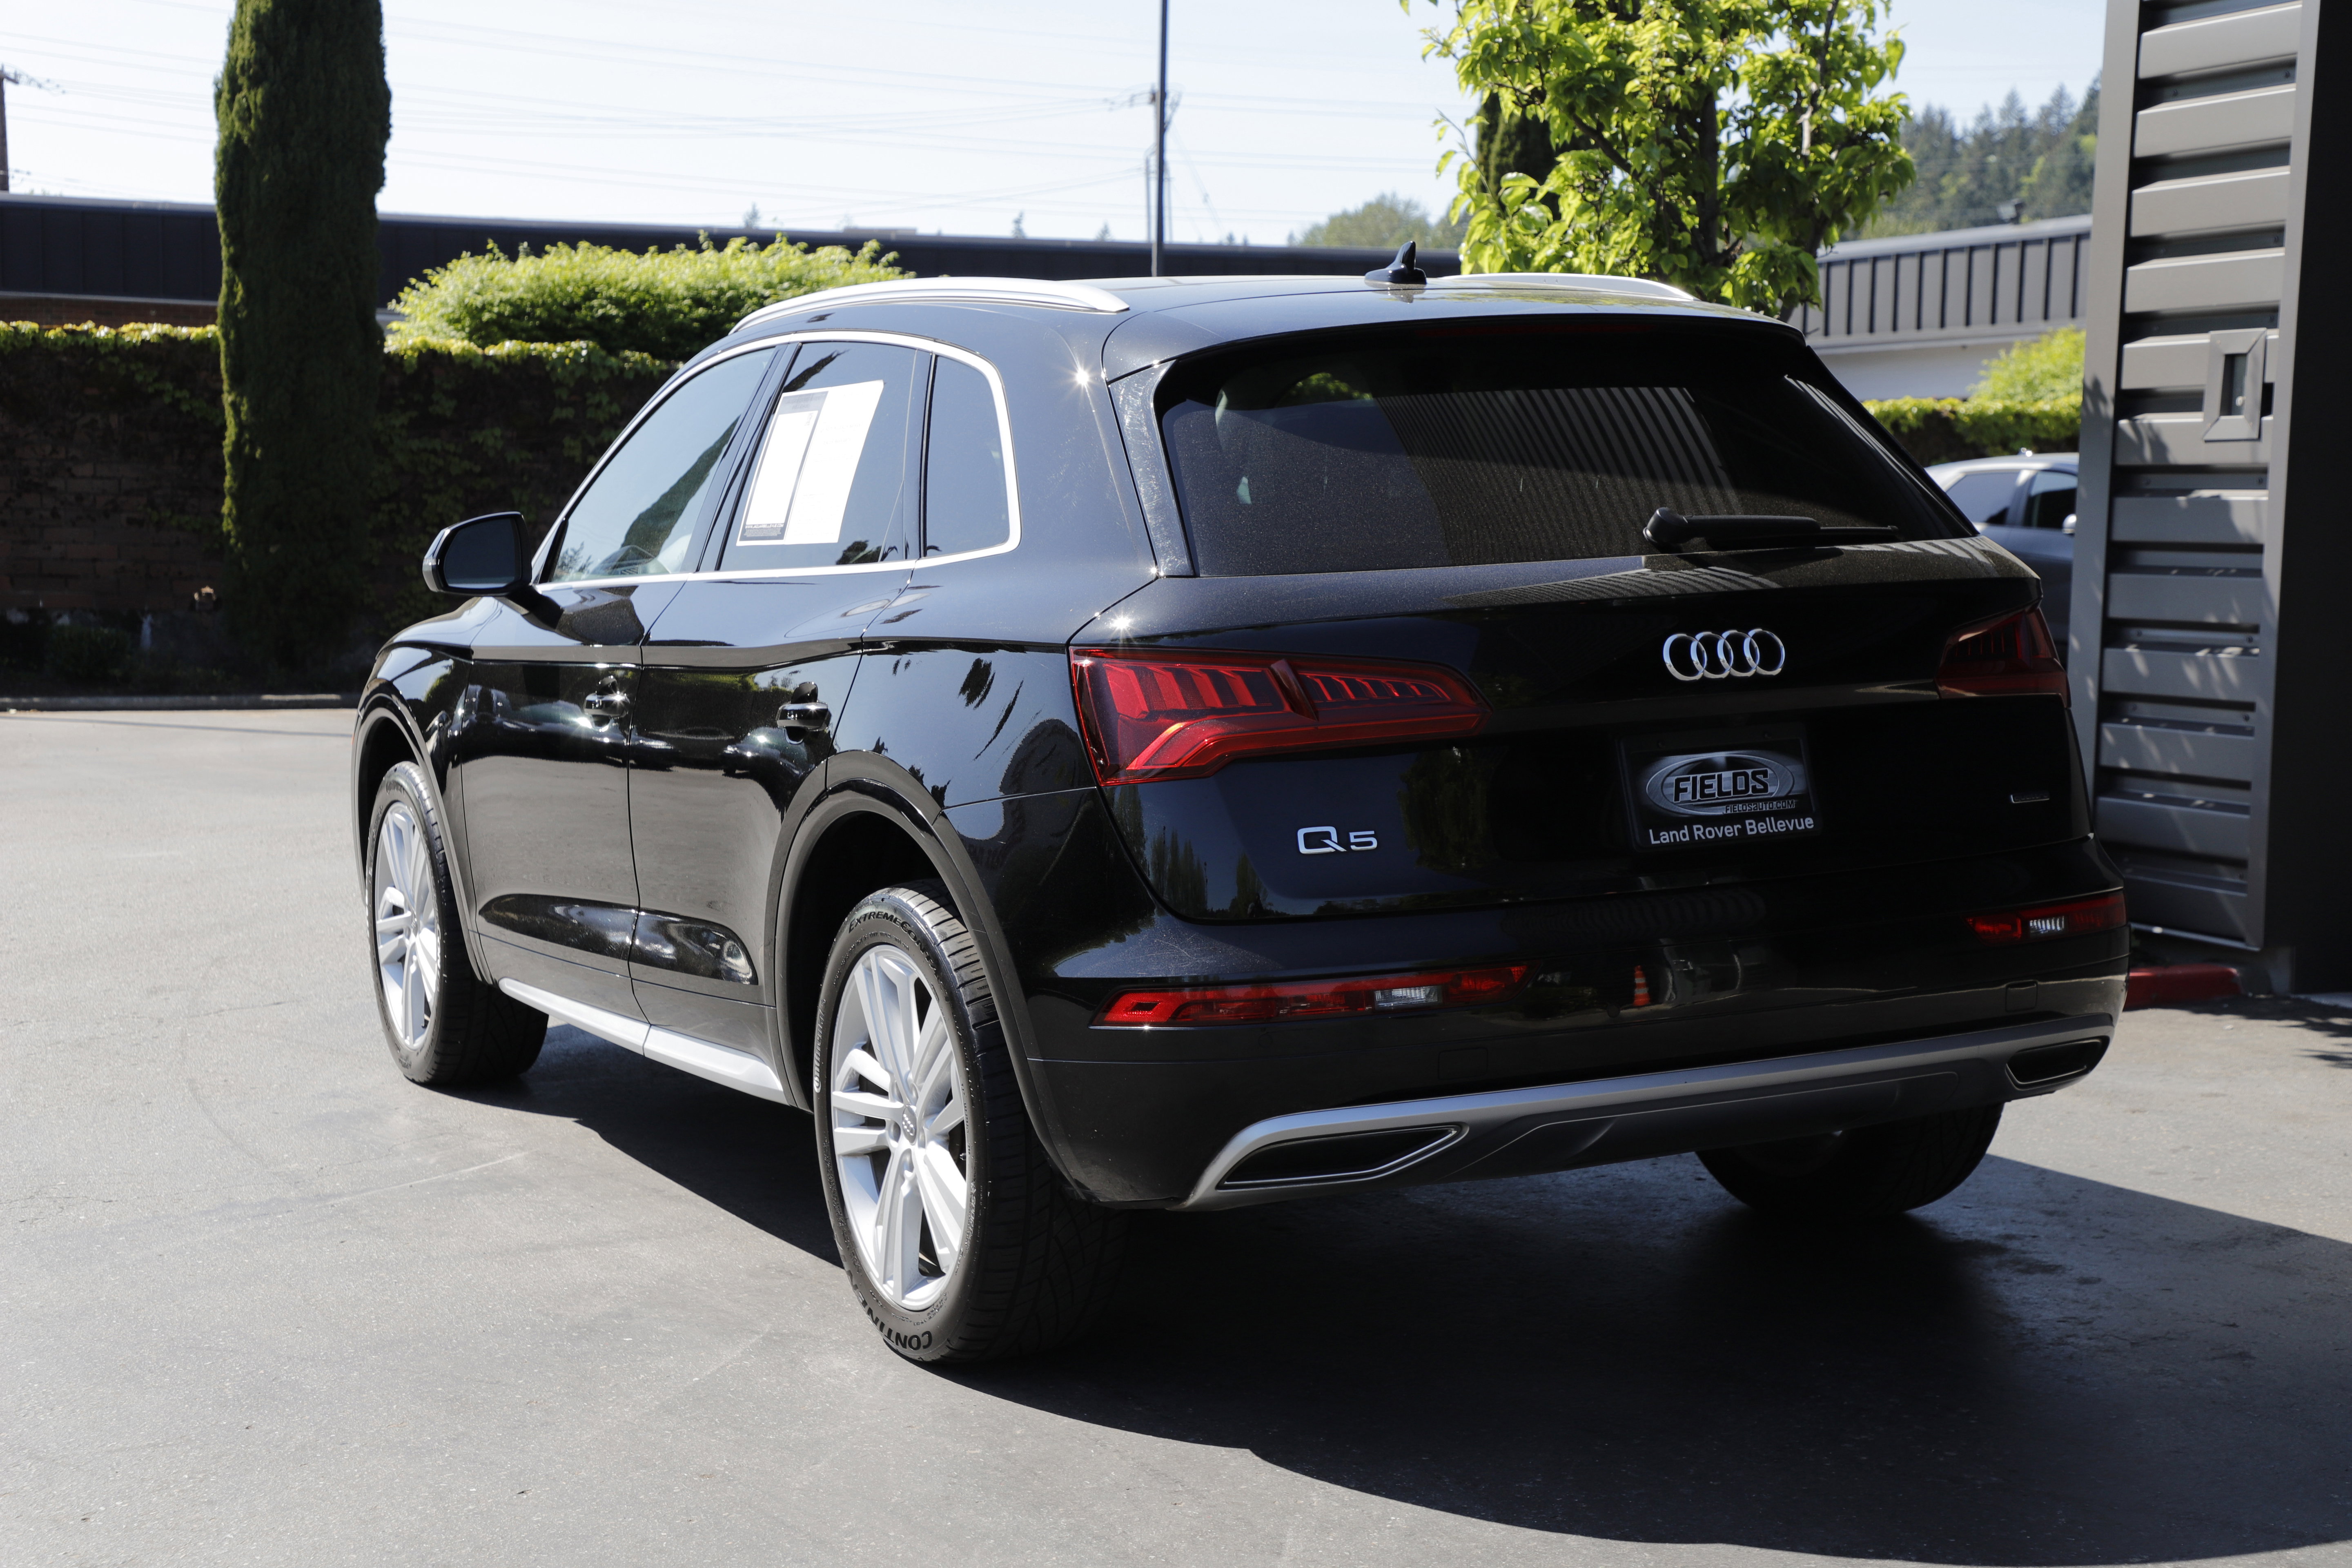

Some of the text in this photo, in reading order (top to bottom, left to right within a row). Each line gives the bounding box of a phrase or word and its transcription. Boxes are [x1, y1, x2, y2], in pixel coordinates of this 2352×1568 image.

[1673, 768, 1769, 803] FIELDS
[1649, 817, 1814, 844] Land Rover Bellevue
